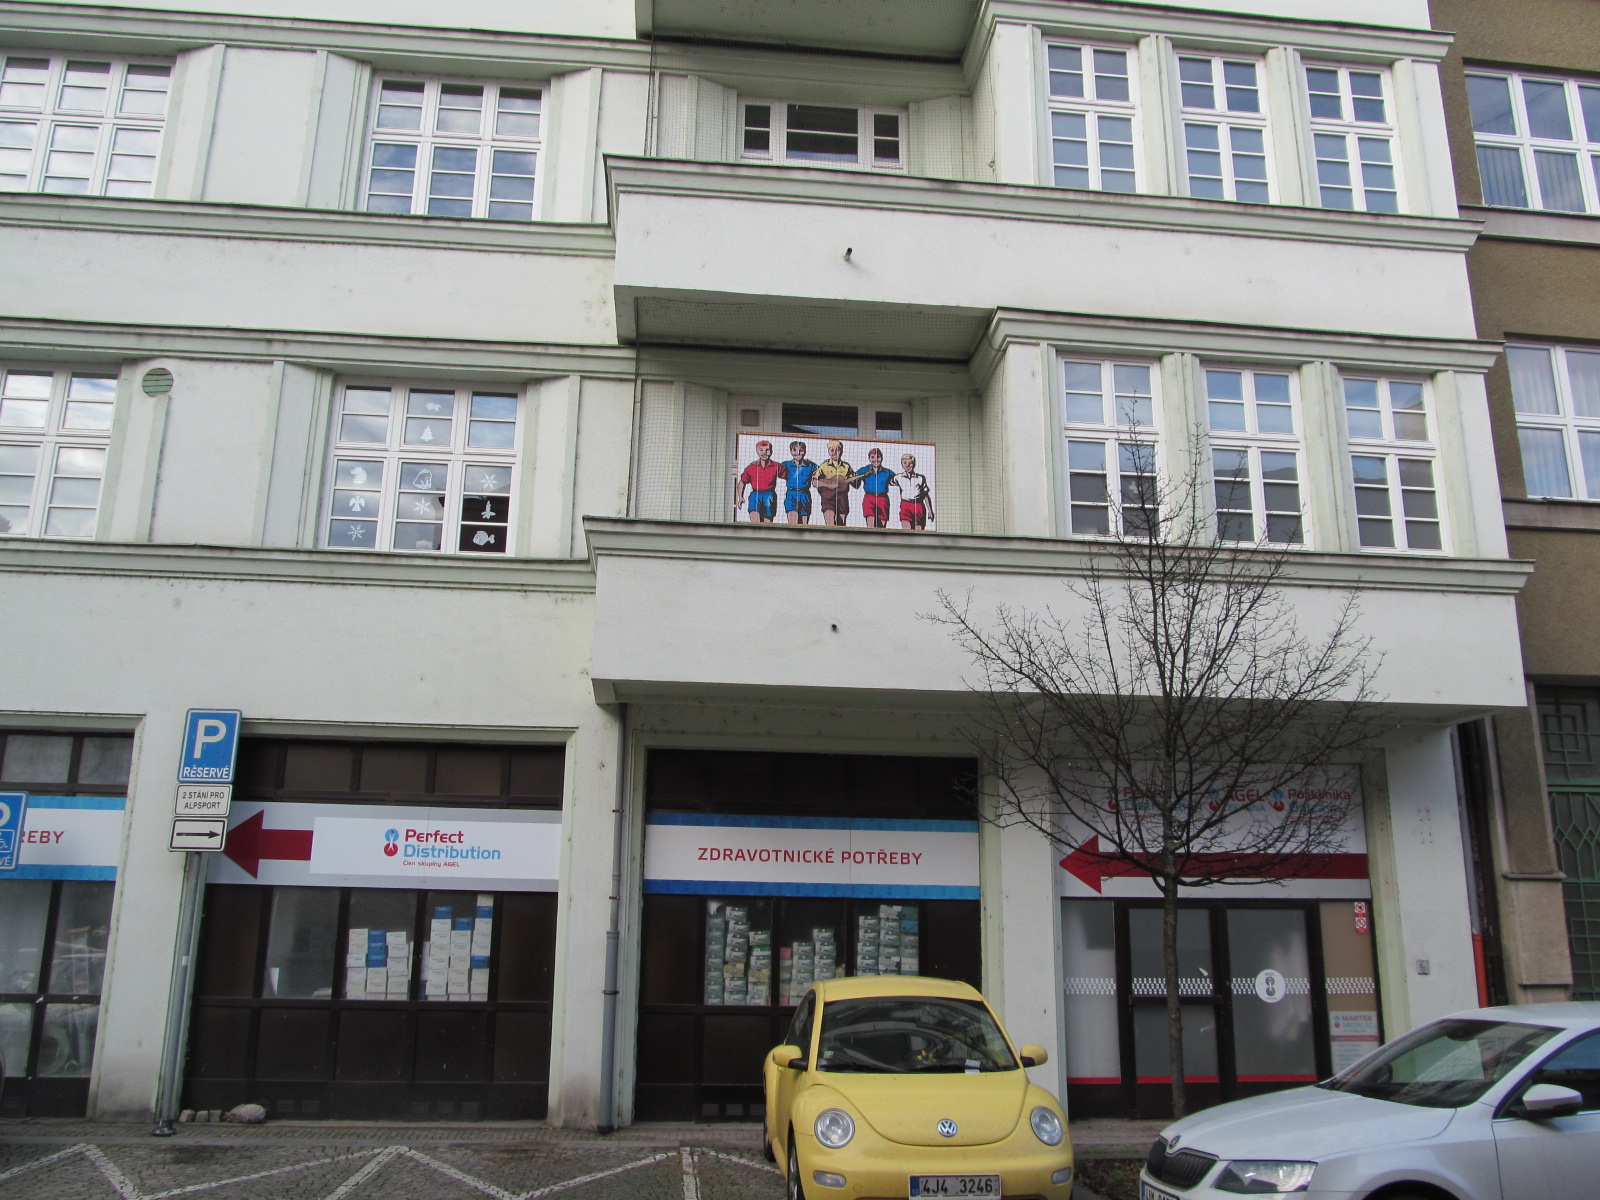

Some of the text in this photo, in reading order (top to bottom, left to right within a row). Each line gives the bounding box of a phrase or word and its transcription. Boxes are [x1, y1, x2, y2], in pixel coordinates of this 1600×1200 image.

[193, 719, 227, 759] P
[183, 764, 230, 778] RÉSERVÉ
[182, 790, 225, 799] 2 STÁNÍ PRO
[184, 801, 221, 809] ALPSPORT
[405, 828, 464, 843] Perfect
[403, 844, 501, 860] Distribution
[697, 847, 922, 865] ZDRAVOTNICKÉ POTŘEBY
[923, 1178, 993, 1194] 4J4 3246
